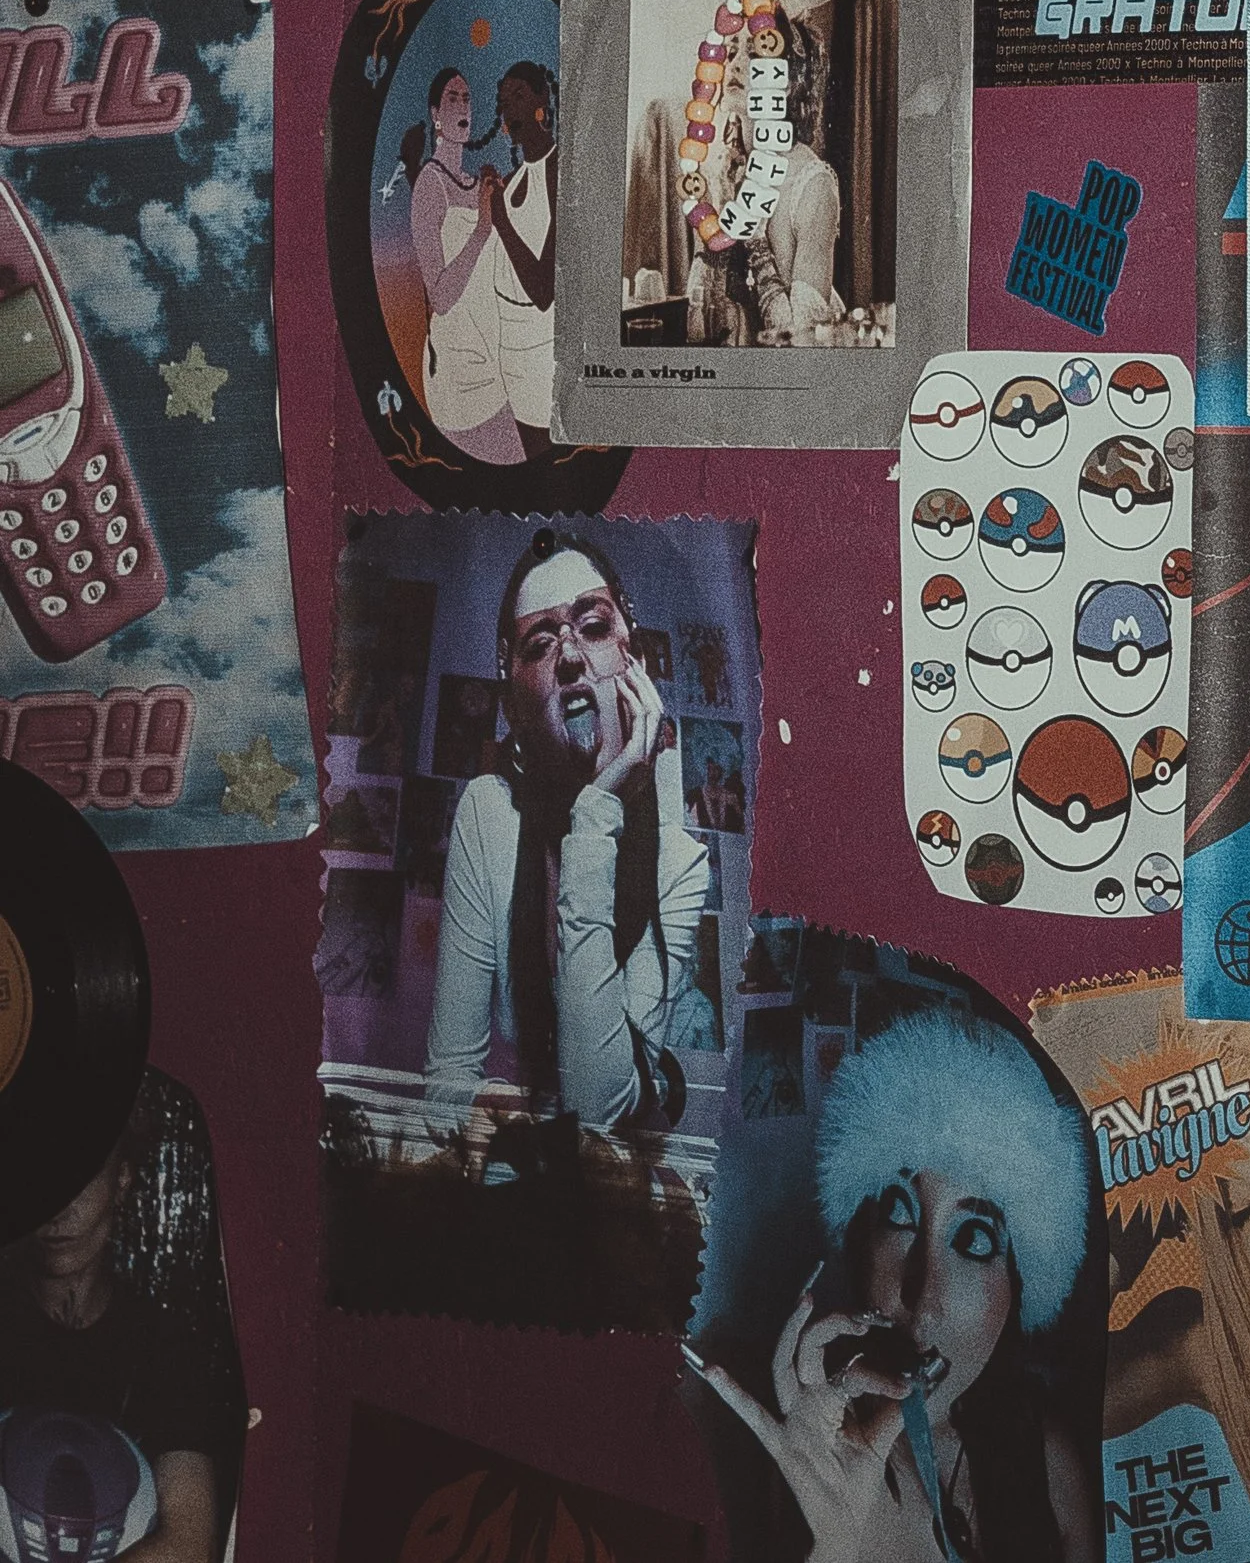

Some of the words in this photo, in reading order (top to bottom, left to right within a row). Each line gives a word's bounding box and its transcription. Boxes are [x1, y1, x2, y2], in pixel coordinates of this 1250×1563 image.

[1136, 56, 1172, 71] Techno
[1145, 38, 1171, 52] 2000
[1182, 36, 1219, 51] Techno
[1082, 166, 1139, 232] POP
[1024, 204, 1125, 288] WOMEN
[1011, 249, 1106, 331] FESTIVAL
[583, 363, 627, 381] like
[631, 368, 645, 380] a
[648, 364, 716, 383] virgin
[48, 492, 60, 509] 2
[90, 460, 101, 476] 3
[19, 541, 29, 557] 4
[60, 523, 73, 540] 5
[33, 569, 43, 585] 7
[75, 553, 86, 570] 8
[111, 522, 122, 539] 9
[1112, 614, 1142, 641] M
[1114, 1443, 1209, 1494] THE
[1104, 1475, 1231, 1535] NEXT
[1131, 1519, 1215, 1563] BIG
